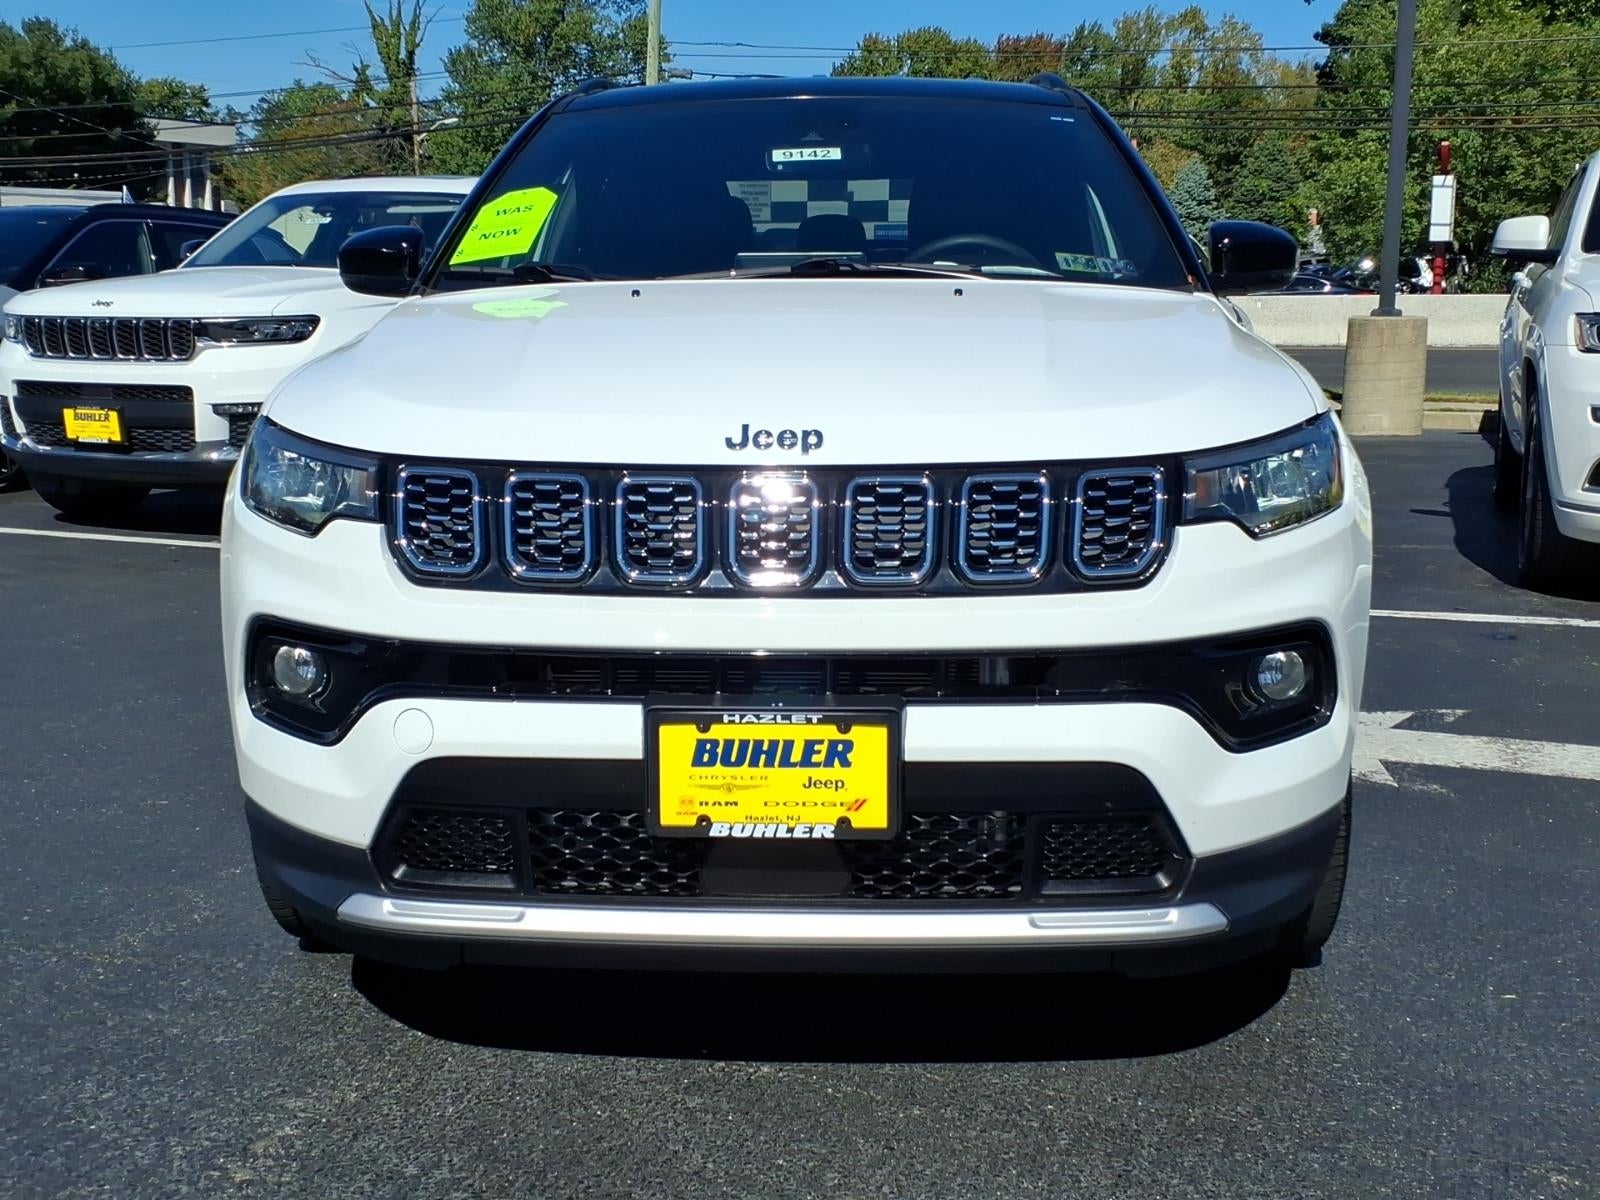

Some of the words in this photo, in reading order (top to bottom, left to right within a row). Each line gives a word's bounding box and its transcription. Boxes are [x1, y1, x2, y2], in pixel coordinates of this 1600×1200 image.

[782, 150, 831, 159] 9142
[496, 204, 533, 216] WAS
[478, 227, 522, 240] NOW
[74, 411, 110, 422] BUHLER
[725, 424, 823, 455] Jeep
[723, 714, 823, 724] HAZLET
[691, 738, 854, 768] BUHLER
[803, 776, 845, 791] Jeep
[708, 822, 835, 838] BUHLER
